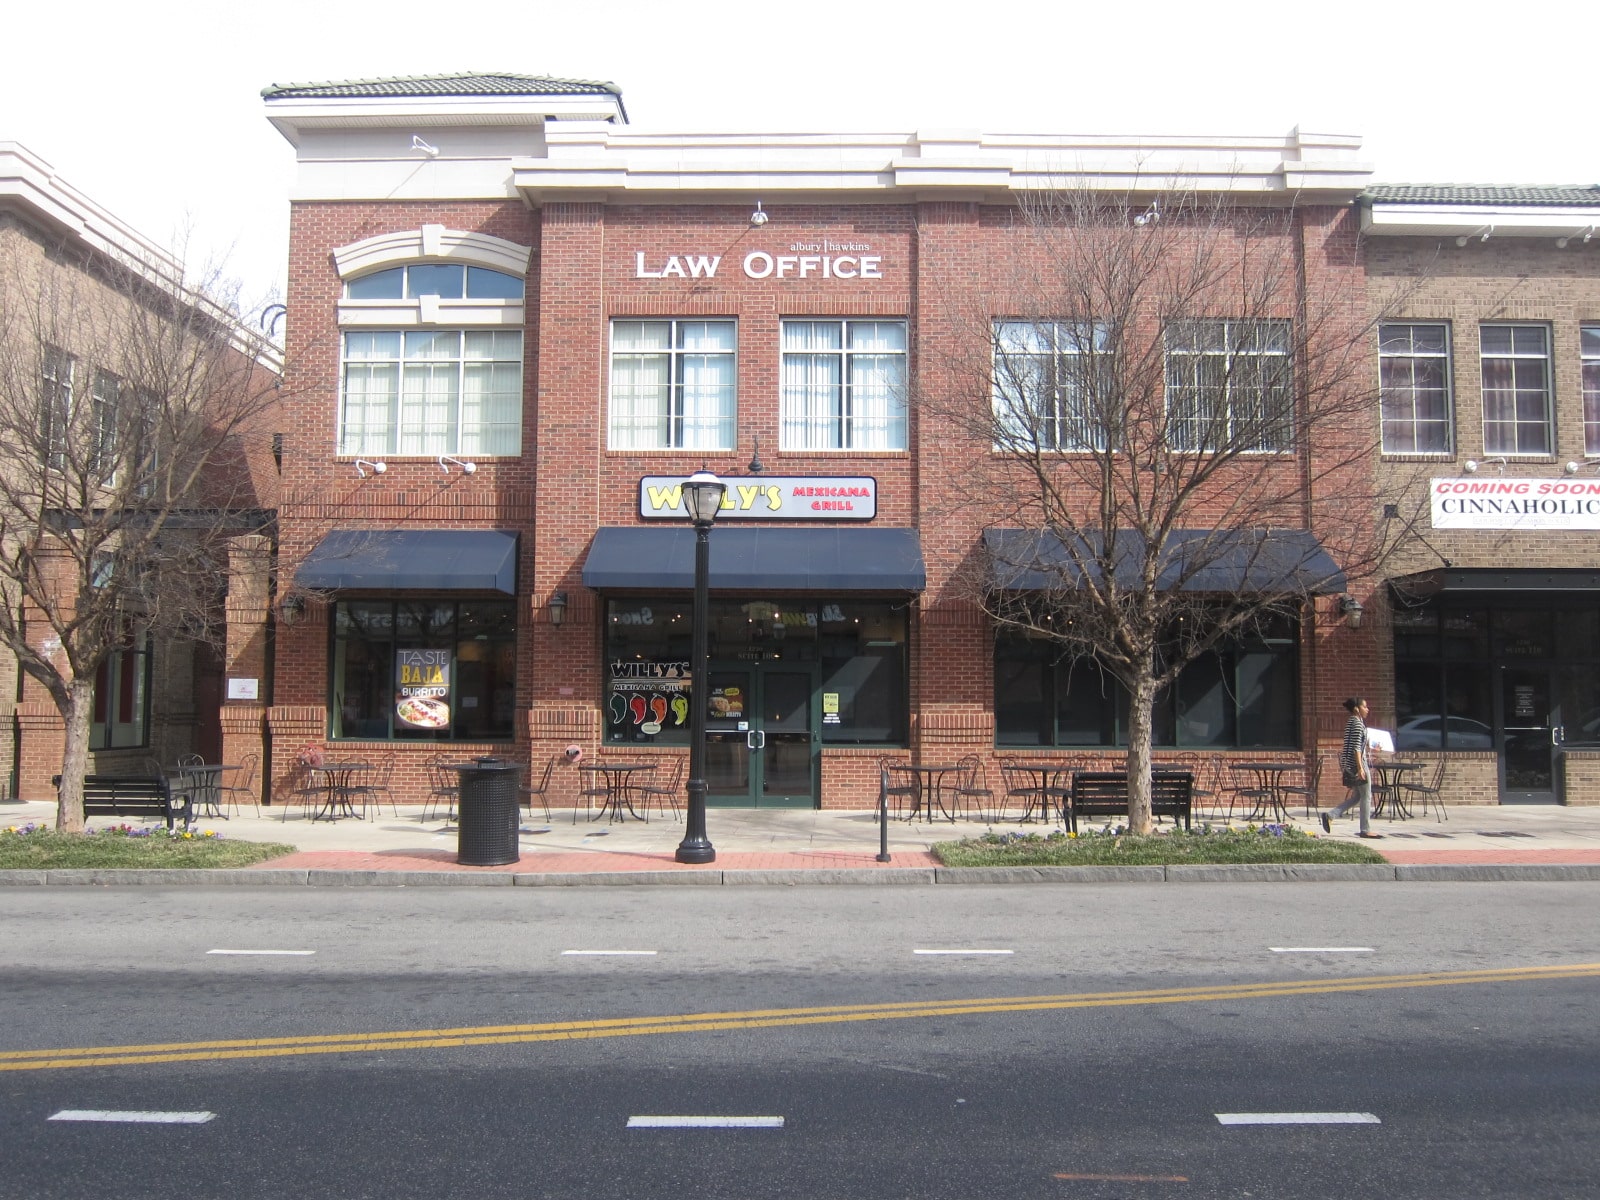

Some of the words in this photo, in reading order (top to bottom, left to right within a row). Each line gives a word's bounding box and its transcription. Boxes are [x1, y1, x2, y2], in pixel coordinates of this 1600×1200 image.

[790, 241, 821, 251] albury
[829, 241, 870, 251] hawkins
[636, 252, 720, 279] LAW
[743, 252, 882, 279] OFFICE
[1436, 482, 1530, 494] COMING
[647, 485, 782, 511] WLY'S
[793, 487, 870, 497] MEXICANA
[811, 500, 853, 511] GRILL
[398, 650, 447, 665] TASTE
[401, 664, 444, 684] BAJA
[611, 662, 690, 678] WILLY'S
[402, 687, 446, 697] BURRITO
[613, 683, 657, 691] MEXICANA
[659, 683, 682, 692] GRILL
